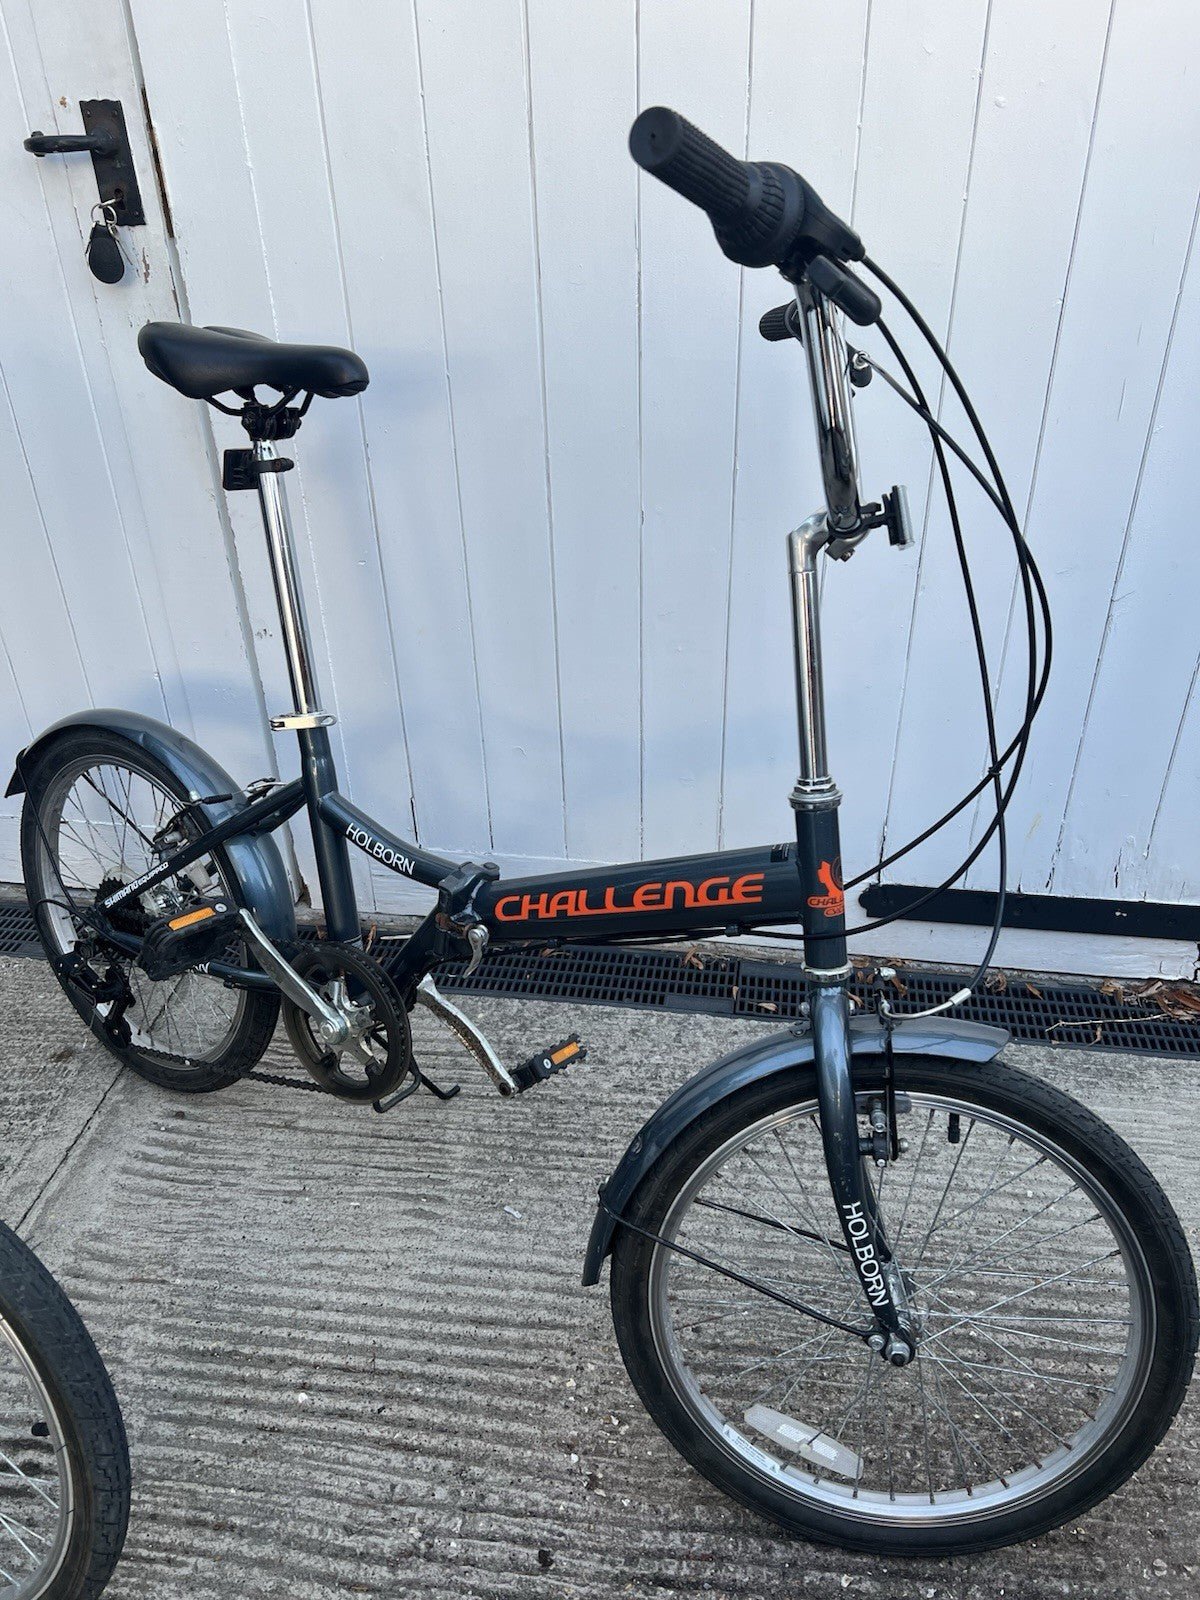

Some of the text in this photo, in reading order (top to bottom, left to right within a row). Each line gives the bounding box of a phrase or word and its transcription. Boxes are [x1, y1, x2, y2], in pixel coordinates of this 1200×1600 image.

[346, 822, 416, 875] HOLBORN
[104, 880, 139, 909] SHIMANO
[494, 873, 765, 922] CHALLENGE
[842, 1201, 890, 1307] HOLBORN
